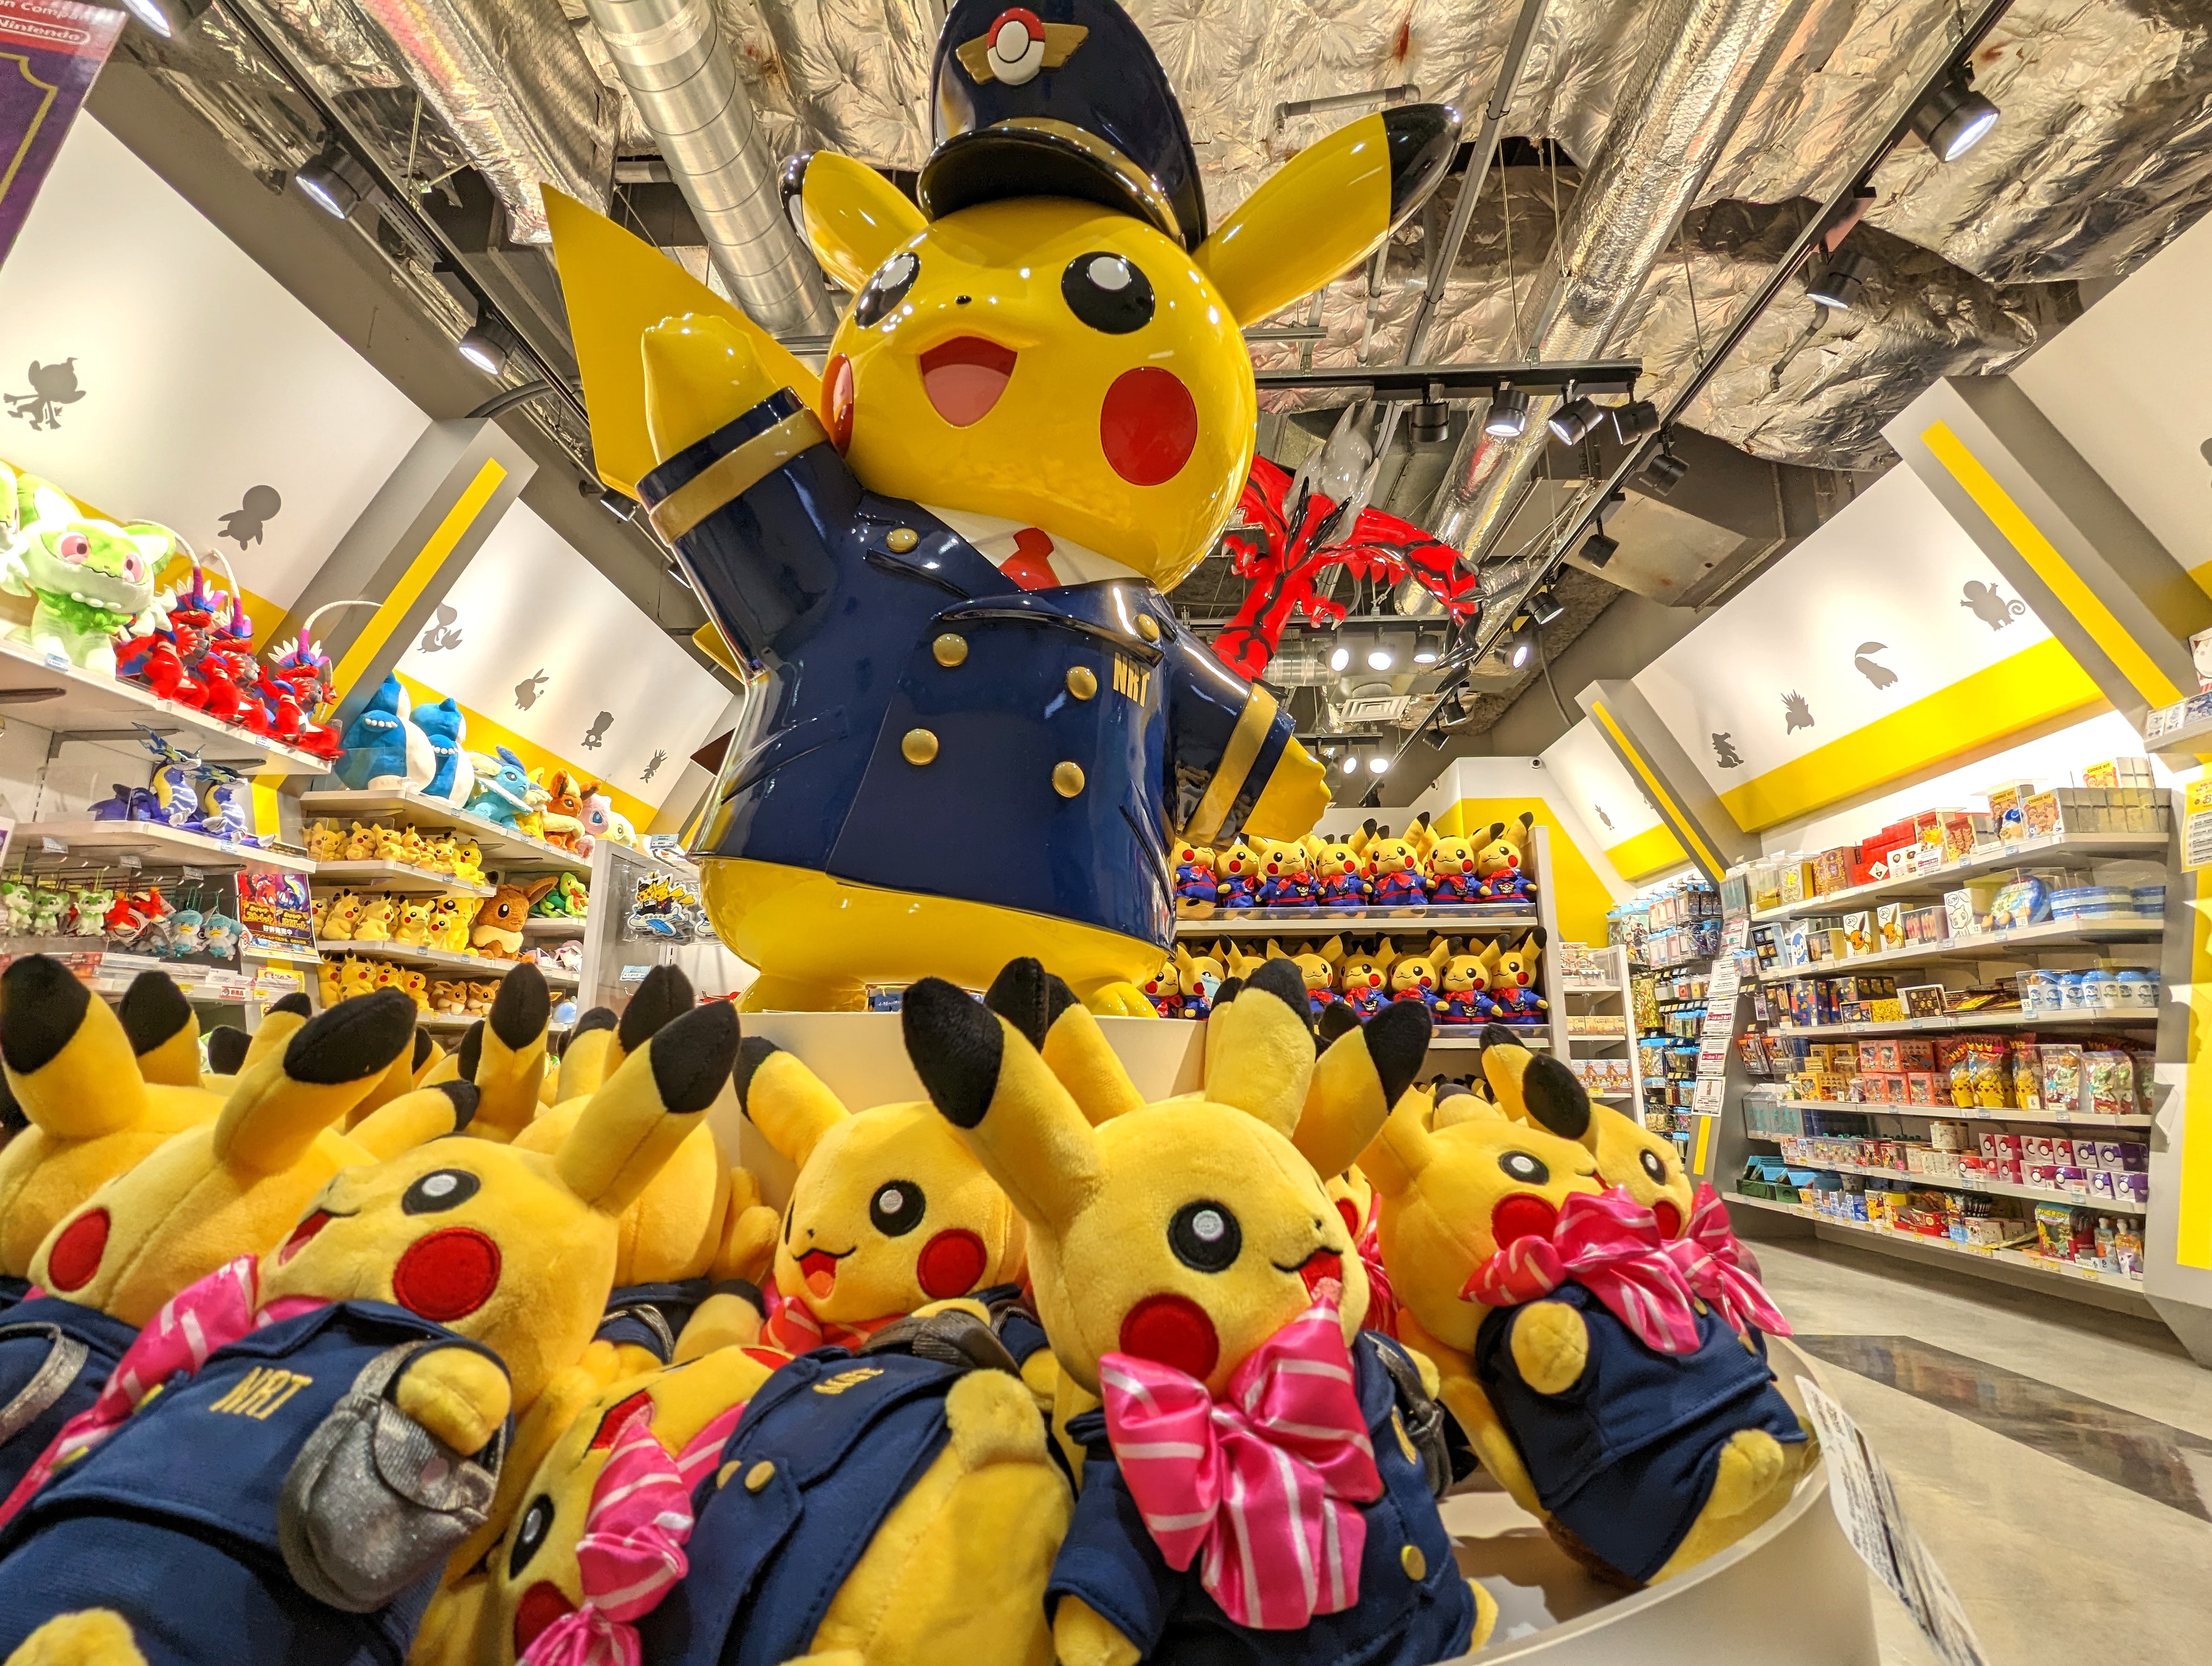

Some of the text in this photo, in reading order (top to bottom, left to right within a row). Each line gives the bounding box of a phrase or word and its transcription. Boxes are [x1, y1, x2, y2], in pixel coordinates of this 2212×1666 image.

[0, 18, 80, 41] Nintendo
[1113, 651, 1150, 708] NRT
[263, 925, 292, 935] 好評発売中
[208, 1366, 313, 1421] NRT
